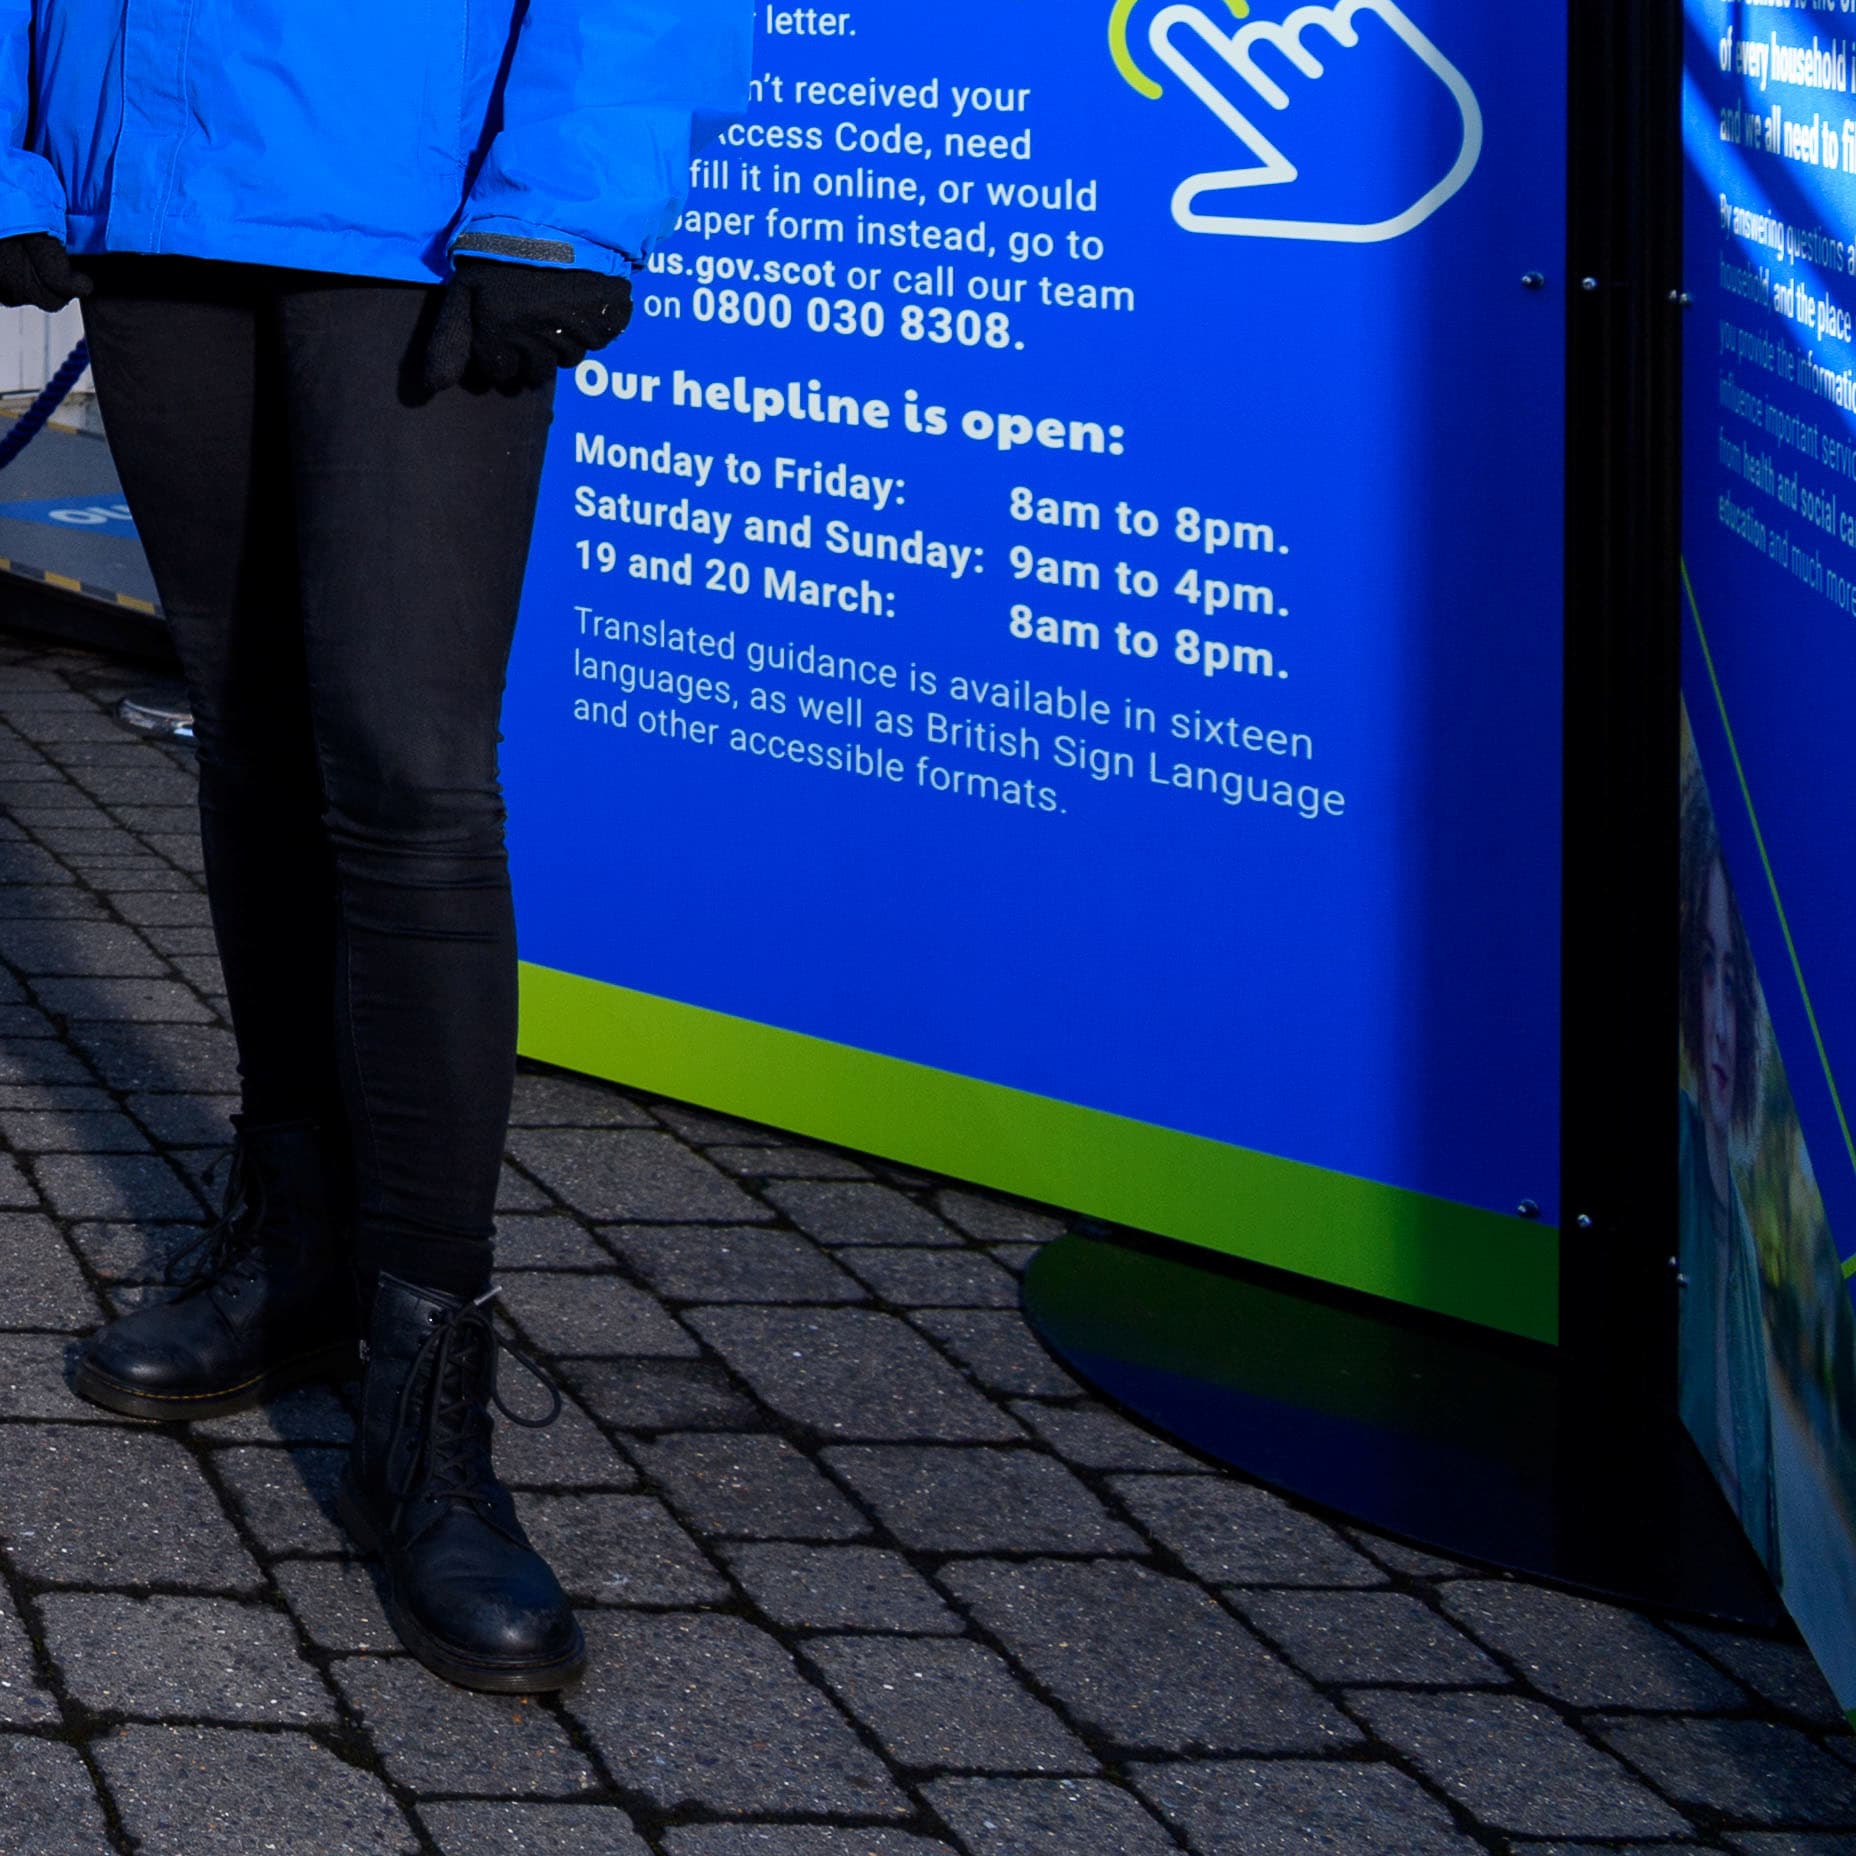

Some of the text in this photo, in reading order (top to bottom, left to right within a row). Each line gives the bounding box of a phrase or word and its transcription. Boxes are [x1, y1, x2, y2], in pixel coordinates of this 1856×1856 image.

[767, 4, 856, 36] letter.
[1771, 31, 1846, 93] household
[795, 77, 1031, 117] received your
[835, 121, 1031, 160] Code, need
[689, 158, 1097, 212] fill it in online, or would
[766, 207, 1104, 263] form instead, go to
[647, 252, 1134, 311] us.gov.scot or call our team
[644, 287, 1025, 350] on 0800 030 8308.
[575, 359, 1124, 455] Our helpline is open:
[48, 504, 133, 524] OU
[575, 432, 1289, 554] Monday to Friday: 8am to 8pm.
[575, 485, 1289, 617] Saturday and Sunday: 9am to 4pm.
[576, 540, 1288, 679] 19 and 20 March: 8am to 8pm.
[575, 606, 1312, 759] Translated guidance is available in sixteen
[574, 699, 1066, 811] and other accessible formats.
[575, 648, 1345, 819] languages, as well as British Sign Language
